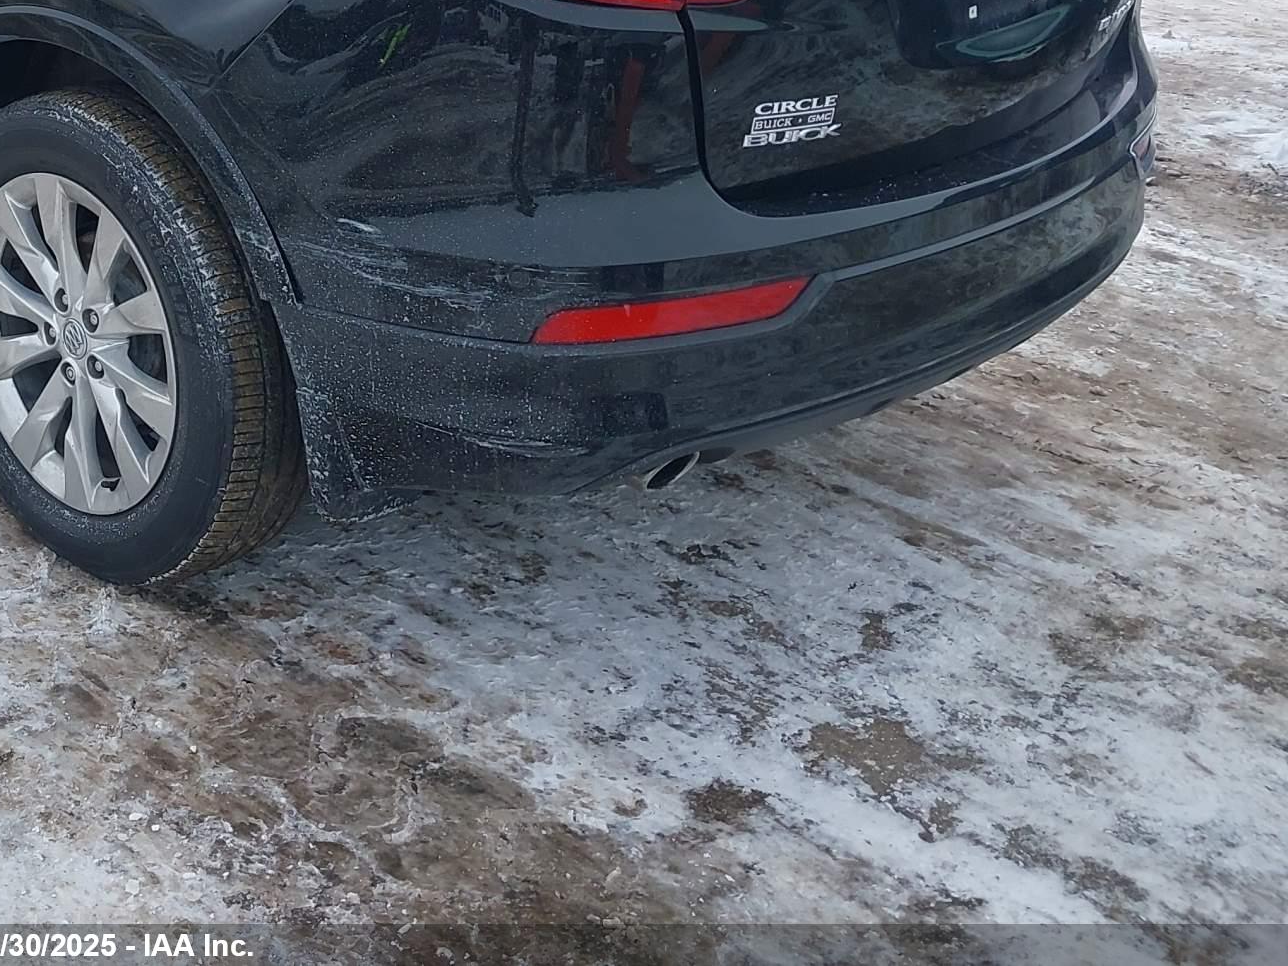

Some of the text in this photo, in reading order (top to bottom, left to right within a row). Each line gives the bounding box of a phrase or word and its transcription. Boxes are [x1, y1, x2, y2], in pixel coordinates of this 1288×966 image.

[754, 94, 839, 115] CIRCLE
[754, 112, 832, 130] BUICK GMC
[742, 123, 842, 148] BUICK
